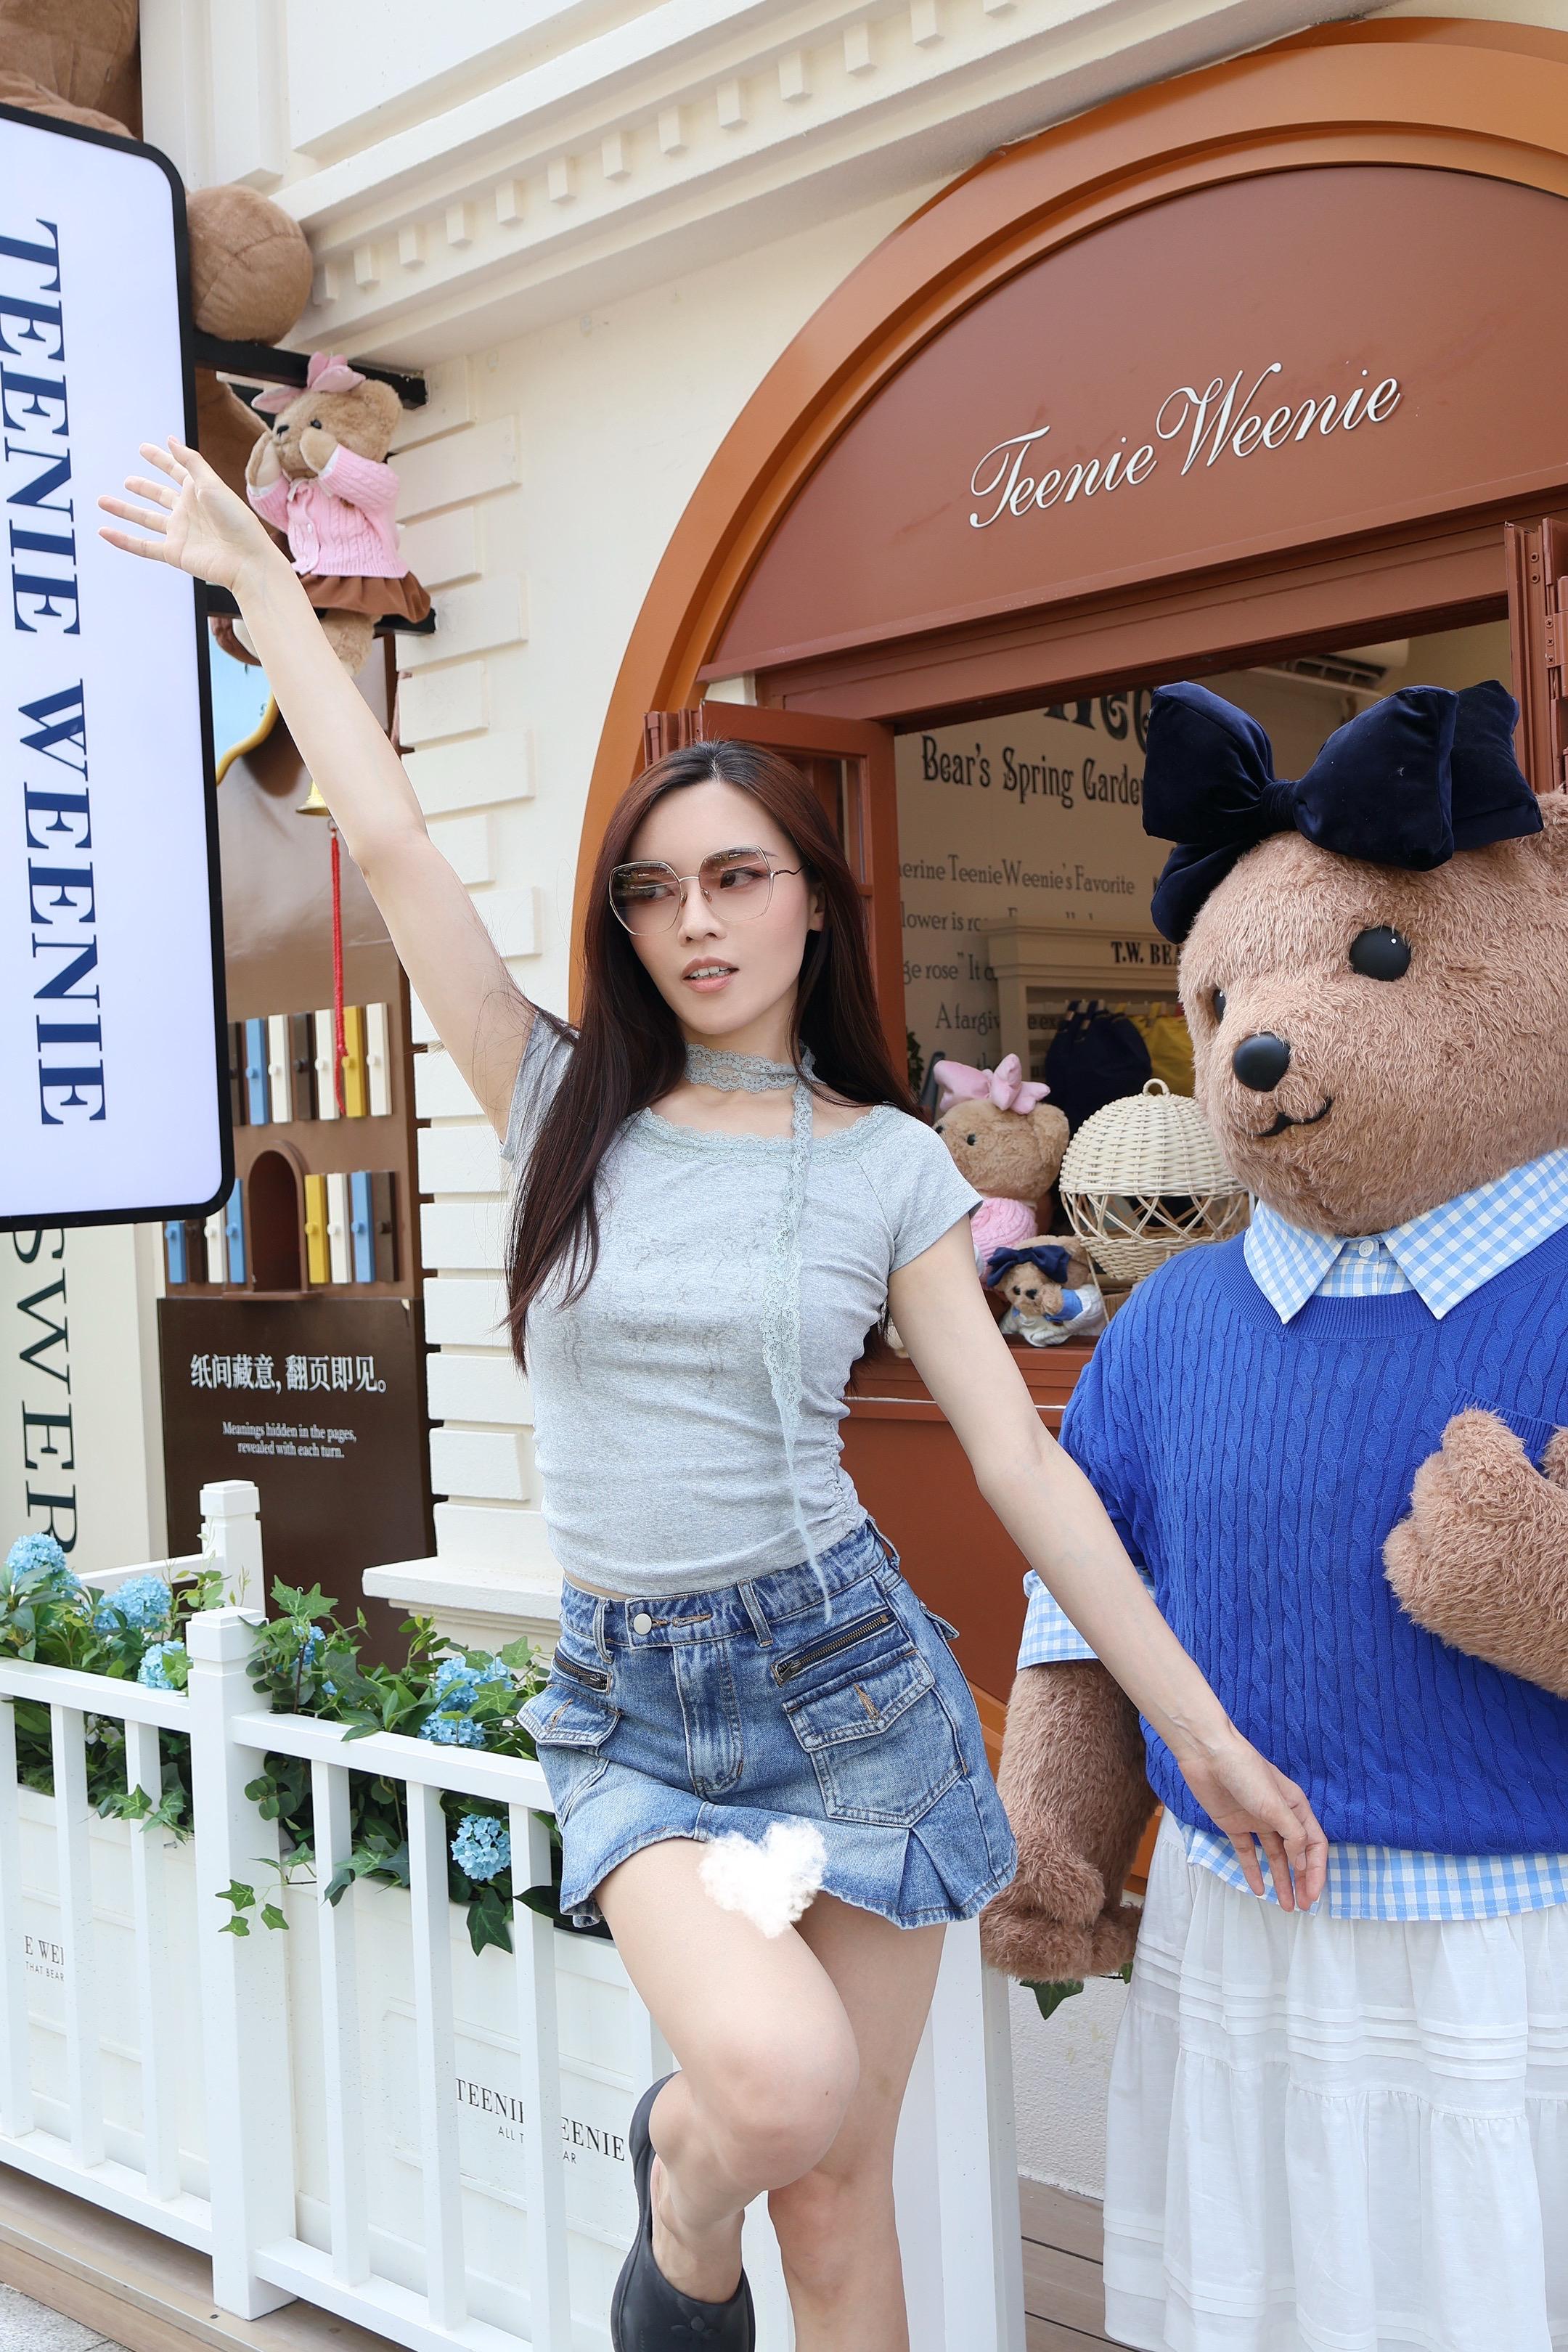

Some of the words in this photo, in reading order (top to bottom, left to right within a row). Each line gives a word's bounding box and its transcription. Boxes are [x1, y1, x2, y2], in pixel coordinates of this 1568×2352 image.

[0, 218, 81, 635] TEENIE
[969, 425, 1158, 528] Teenie
[1156, 362, 1402, 477] Weenie
[921, 735, 991, 788] Bear's
[1003, 746, 1074, 809] Spring
[1082, 758, 1144, 805] Garde
[1075, 865, 1135, 895] Favorite
[18, 678, 107, 1125] WEENIE
[952, 911, 964, 931] is
[1110, 940, 1144, 964] T.W.
[222, 1421, 265, 1440] Meanings
[265, 1422, 298, 1438] hidden
[298, 1424, 309, 1438] in
[310, 1424, 326, 1440] the
[327, 1428, 357, 1444] pages,
[237, 1440, 275, 1455] revealed
[275, 1441, 296, 1456] with
[298, 1442, 319, 1457] each
[321, 1445, 345, 1458] turn.
[497, 2126, 515, 2141] ALL
